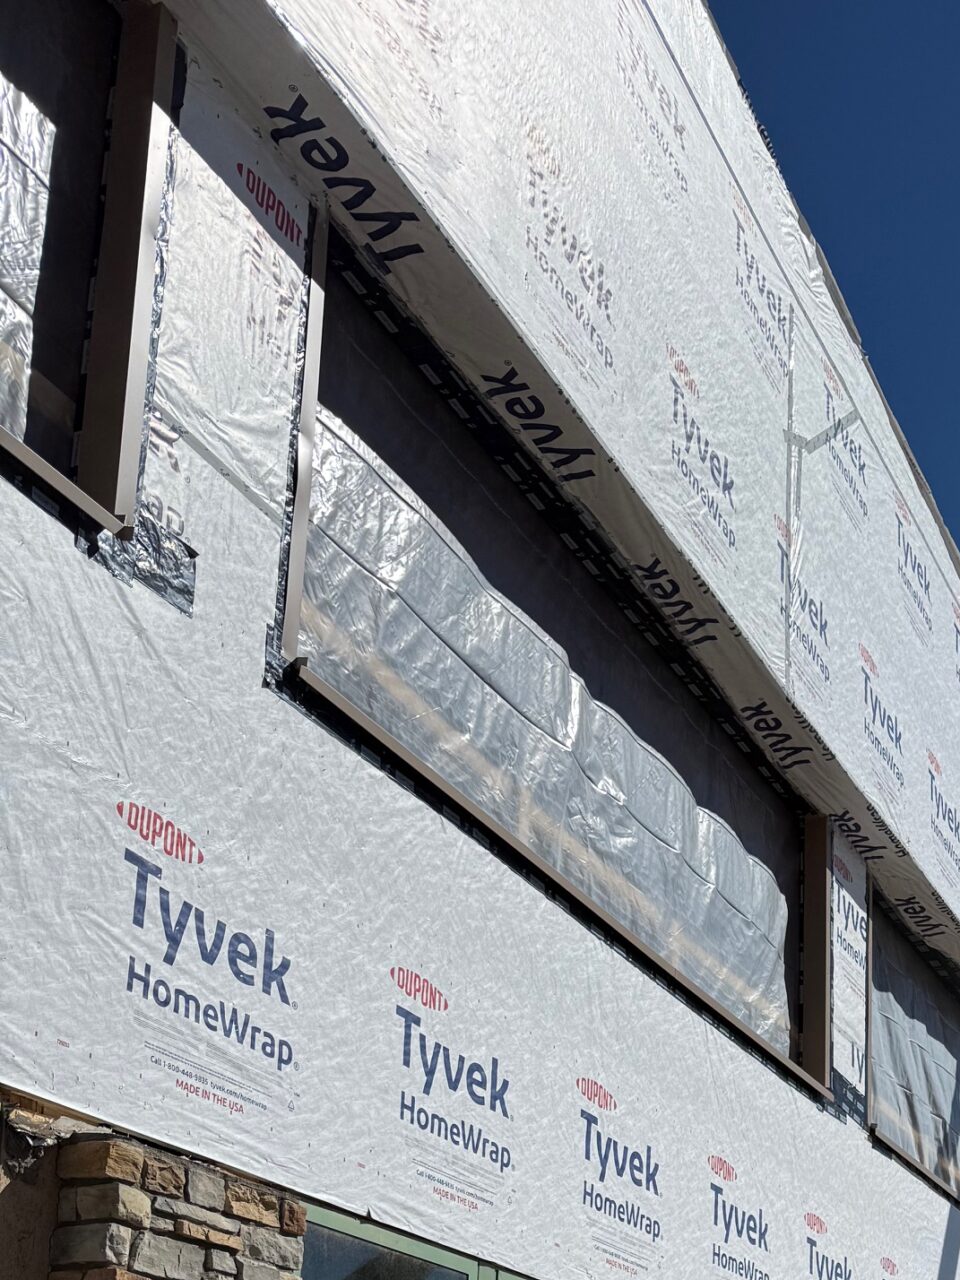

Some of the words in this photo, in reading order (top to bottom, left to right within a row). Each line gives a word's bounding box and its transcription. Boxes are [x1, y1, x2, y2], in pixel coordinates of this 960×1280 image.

[245, 168, 303, 247] DUPONT
[263, 93, 425, 276] Tyvek
[669, 372, 735, 510] Tyvek
[671, 439, 736, 549] HomeWrap
[895, 512, 931, 603] Tyvek
[861, 666, 903, 758] Tyvek
[126, 801, 196, 865] DUPONT
[928, 767, 960, 845] Tyvek
[124, 847, 291, 1007] Tyvek
[835, 878, 867, 942] Tyve
[126, 955, 293, 1072] HomeWrap
[397, 966, 443, 1011] DUPONT
[175, 1078, 200, 1096] MADE
[201, 1089, 211, 1100] IN
[211, 1093, 228, 1108] THE
[228, 1100, 245, 1115] USA
[396, 1004, 509, 1119] Tyvek
[580, 1077, 613, 1111] DUPONT
[400, 1090, 511, 1173] HomeWrap
[580, 1108, 659, 1196] Tyvek
[433, 1186, 449, 1199] MADE
[583, 1180, 661, 1243] HomeWrap
[710, 1182, 769, 1252] Tyvek
